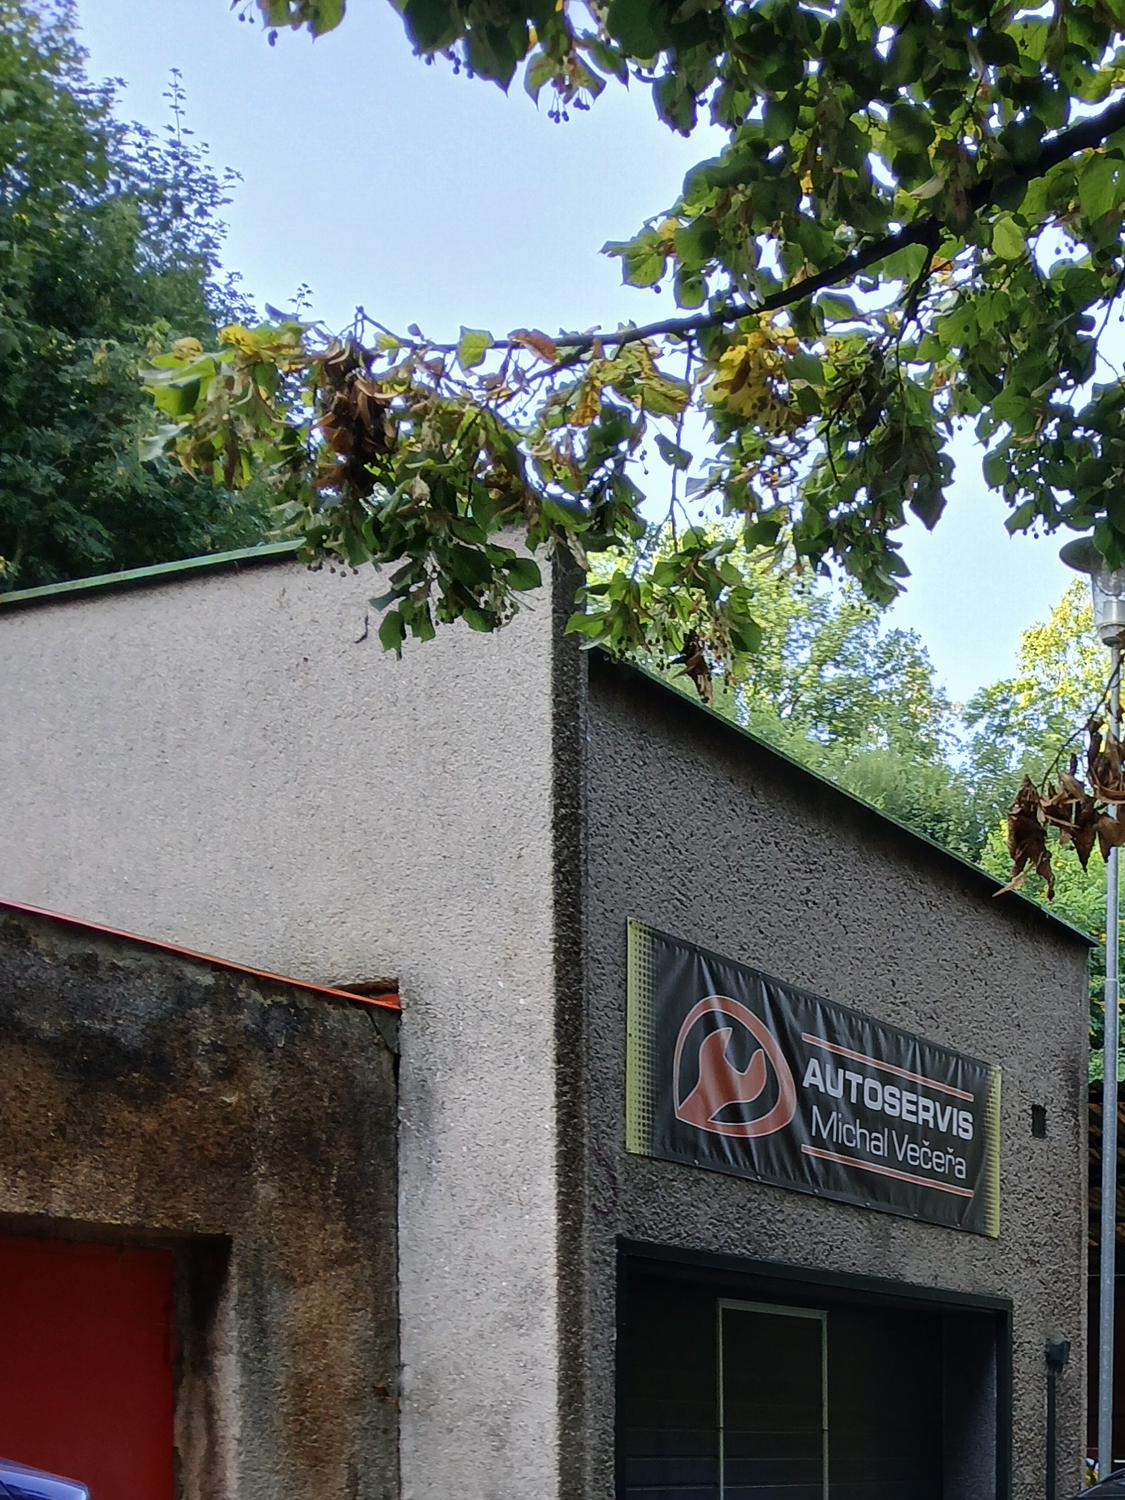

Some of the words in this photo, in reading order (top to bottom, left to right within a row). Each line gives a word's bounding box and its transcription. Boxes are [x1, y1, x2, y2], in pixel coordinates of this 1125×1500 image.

[802, 1057, 974, 1141] AUTOSERVIS
[811, 1104, 889, 1158] Michal
[892, 1129, 967, 1180] Večeřa
